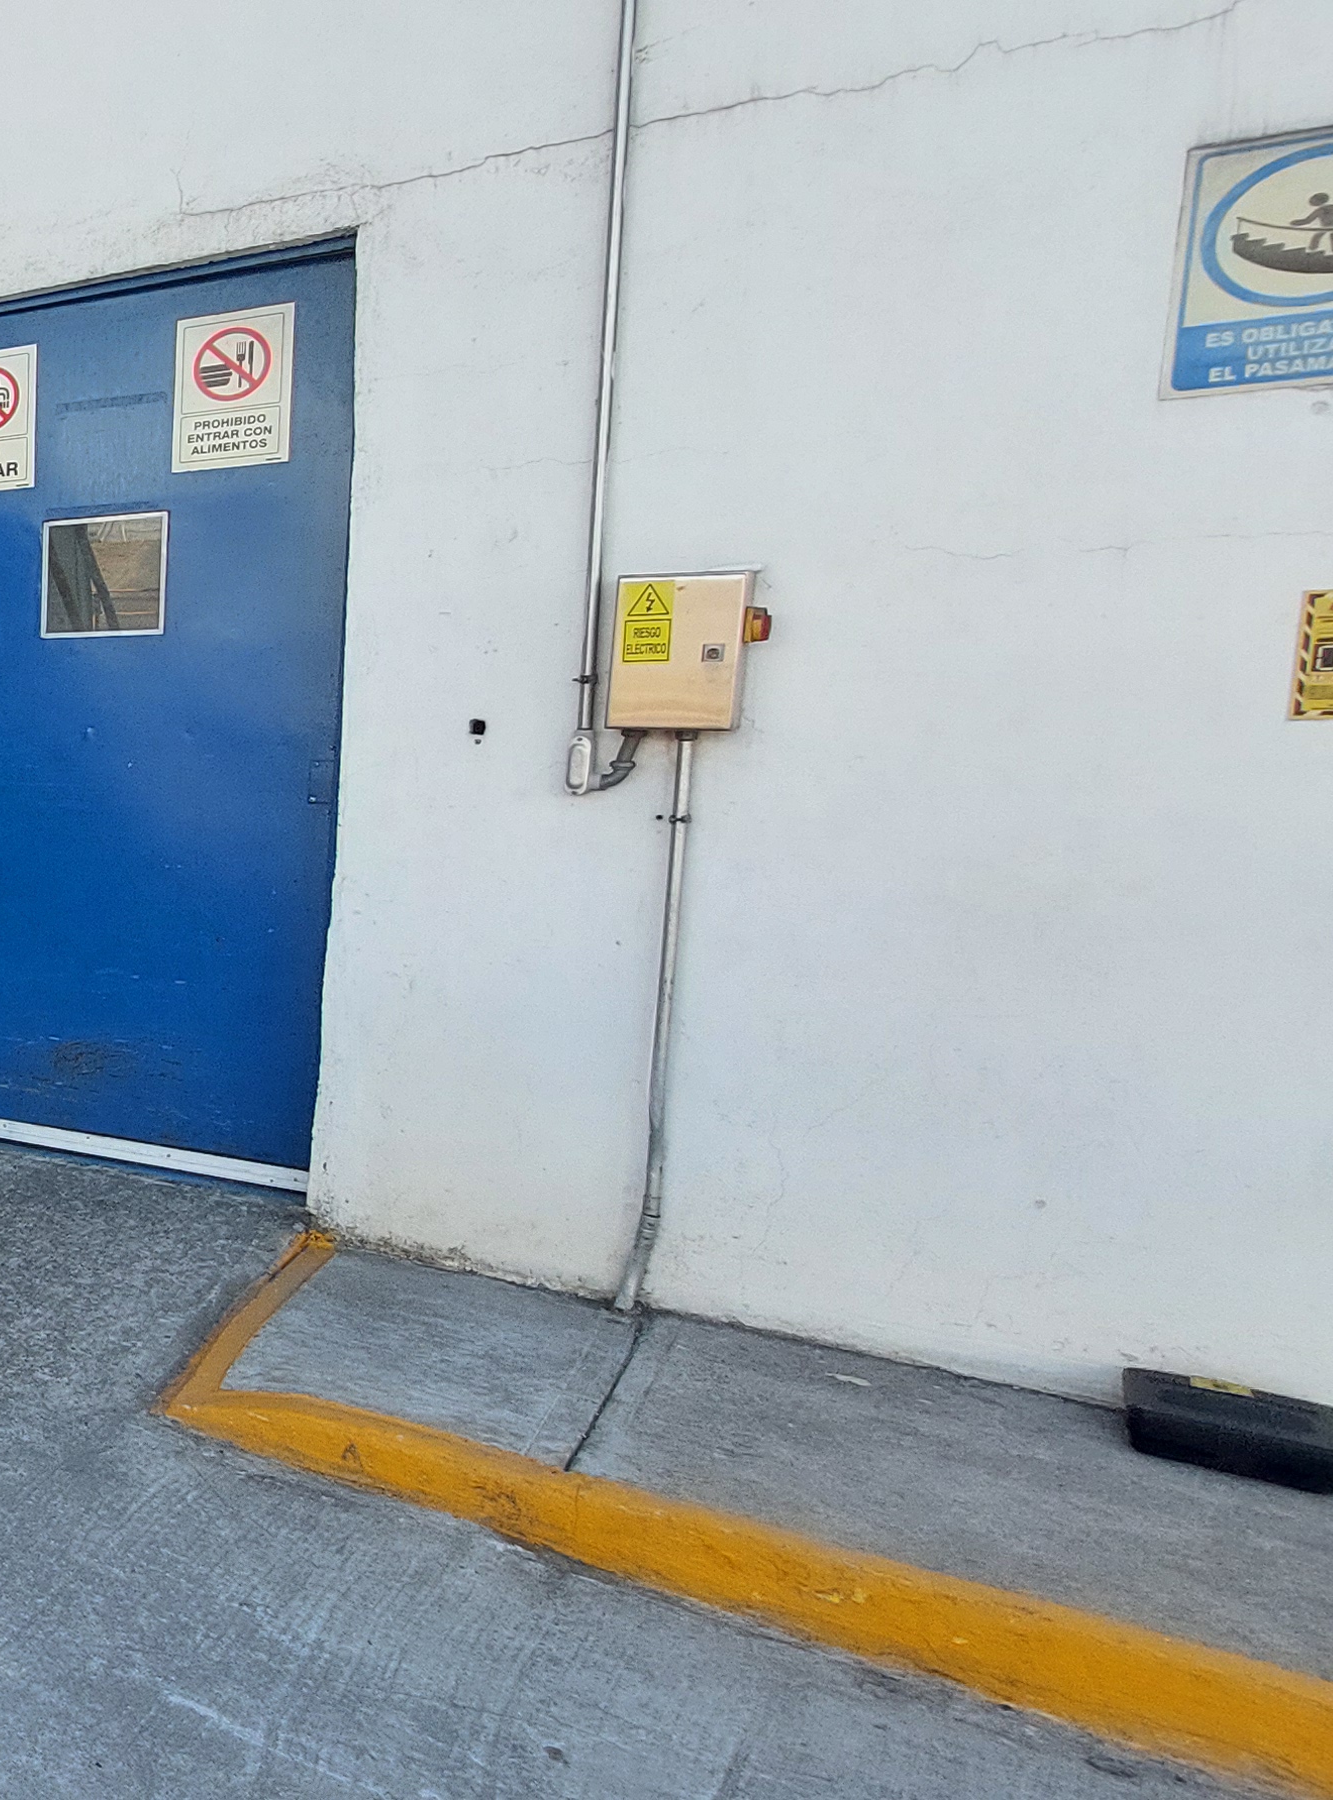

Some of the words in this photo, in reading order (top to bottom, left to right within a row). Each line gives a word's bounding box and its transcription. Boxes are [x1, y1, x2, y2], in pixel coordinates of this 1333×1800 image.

[1205, 330, 1235, 348] ES
[1208, 366, 1237, 383] EL
[194, 413, 267, 431] PROHIBIDO
[187, 429, 240, 444] ENTRAR
[243, 425, 273, 438] CON
[191, 438, 268, 455] ALIMENTOS
[633, 626, 662, 639] RIESGO
[626, 642, 667, 655] ELECTRICO
